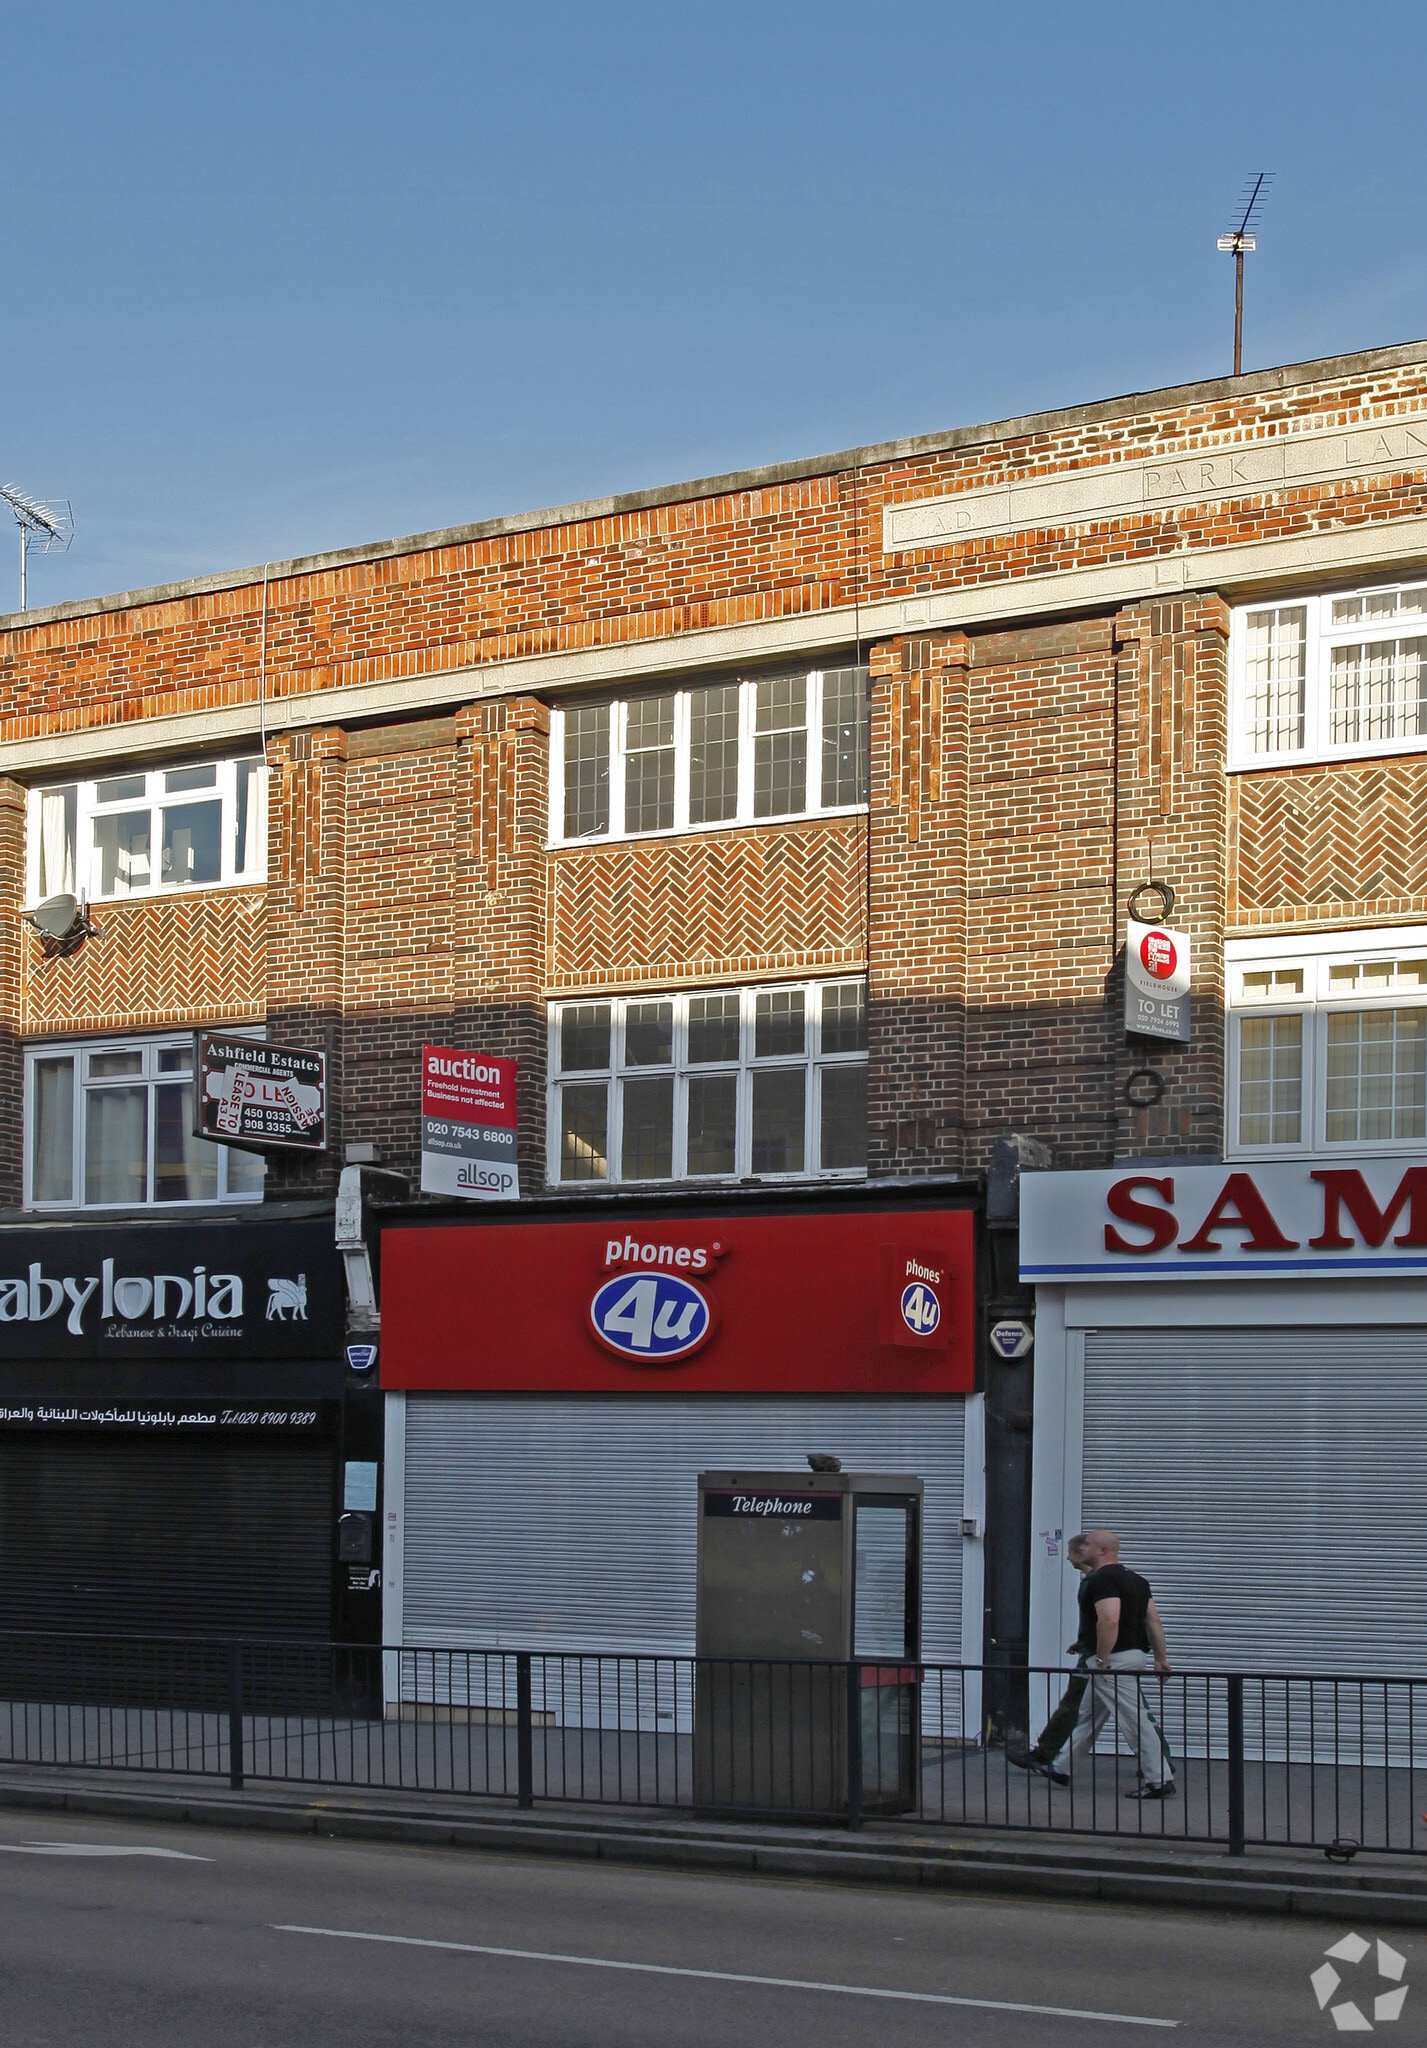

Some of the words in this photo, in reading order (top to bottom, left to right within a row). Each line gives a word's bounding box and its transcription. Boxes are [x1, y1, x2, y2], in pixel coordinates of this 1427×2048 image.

[1145, 456, 1249, 497] PARK
[1343, 429, 1427, 464] LAN
[1139, 980, 1178, 993] FIELDHOUSE
[1137, 1014, 1148, 1023] 020
[1138, 998, 1155, 1014] TO
[1160, 1003, 1180, 1020] LET
[207, 1043, 266, 1064] Ashfield
[271, 1052, 320, 1072] Estates
[234, 1062, 271, 1075] COMMERCIAL
[272, 1067, 294, 1078] AGENTS
[427, 1056, 500, 1085] auction
[229, 1072, 246, 1110] LEASE
[427, 1079, 459, 1092] Freehold
[460, 1084, 500, 1099] investment
[427, 1089, 459, 1102] Business
[461, 1096, 473, 1105] not
[474, 1097, 504, 1109] affected
[220, 1097, 229, 1115] A3
[244, 1107, 263, 1119] 450
[266, 1110, 292, 1122] 0333
[281, 1086, 309, 1128] ASSIGN
[227, 1114, 238, 1129] TO
[244, 1119, 264, 1130] 908
[266, 1121, 292, 1133] 3355
[427, 1121, 449, 1135] 020
[451, 1126, 480, 1140] 7543
[483, 1130, 513, 1145] 6800
[427, 1137, 462, 1150] allsop.co.uk
[457, 1163, 513, 1193] allsop
[1104, 1166, 1427, 1253] SAM
[605, 1235, 707, 1268] phones
[905, 1258, 940, 1284] phones
[0, 1258, 243, 1335] abylonia
[603, 1279, 700, 1348] 4u
[905, 1286, 937, 1330] 4u
[105, 1323, 155, 1338] Lebanese
[157, 1327, 165, 1338] &
[168, 1324, 199, 1342] Iraqi
[201, 1322, 244, 1338] Cuisine
[37, 1405, 78, 1423] اللبنانية
[79, 1407, 136, 1424] للمأكولات
[137, 1410, 176, 1426] بابلونيا
[177, 1411, 216, 1426] مطعم
[260, 1411, 288, 1425] 8900
[289, 1411, 317, 1425] 9389
[732, 1496, 812, 1516] Telephone
